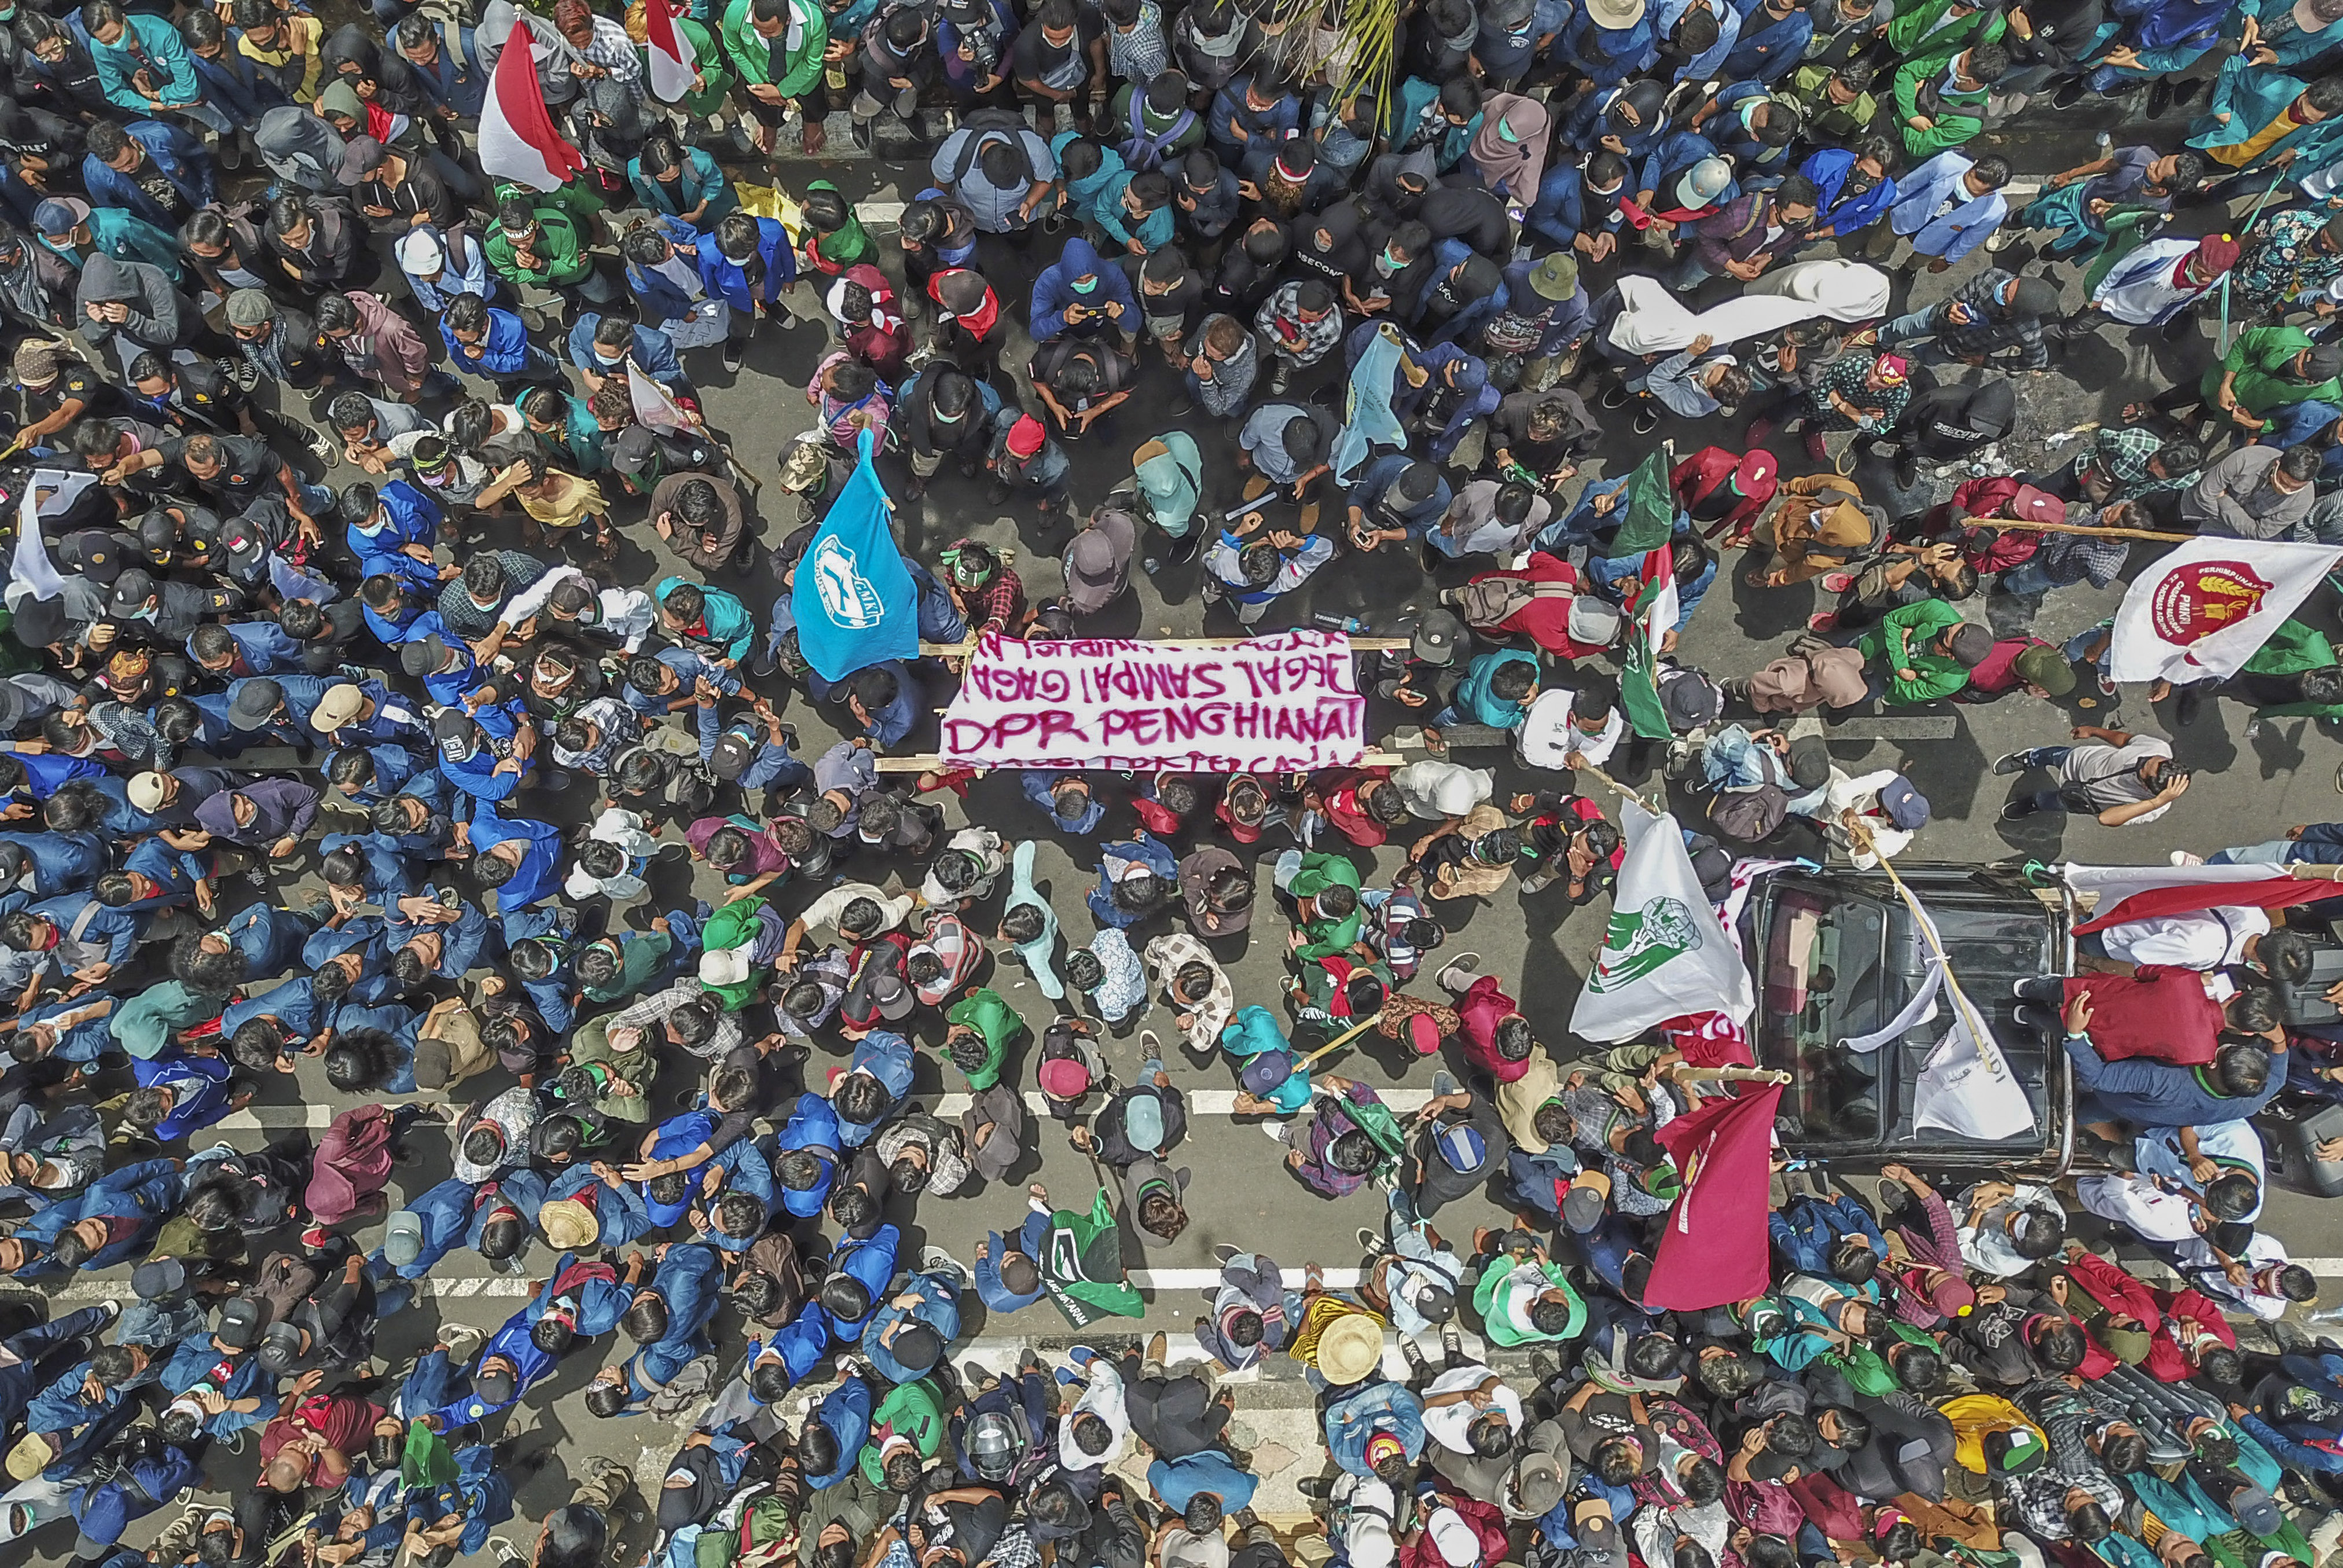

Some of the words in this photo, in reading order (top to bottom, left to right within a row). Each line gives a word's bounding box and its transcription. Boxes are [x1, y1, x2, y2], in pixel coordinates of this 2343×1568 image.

[854, 581, 879, 614] GMKI
[1080, 660, 1226, 703] SAMPAI
[1233, 653, 1359, 698] JEGAL
[944, 709, 1090, 754] DPR
